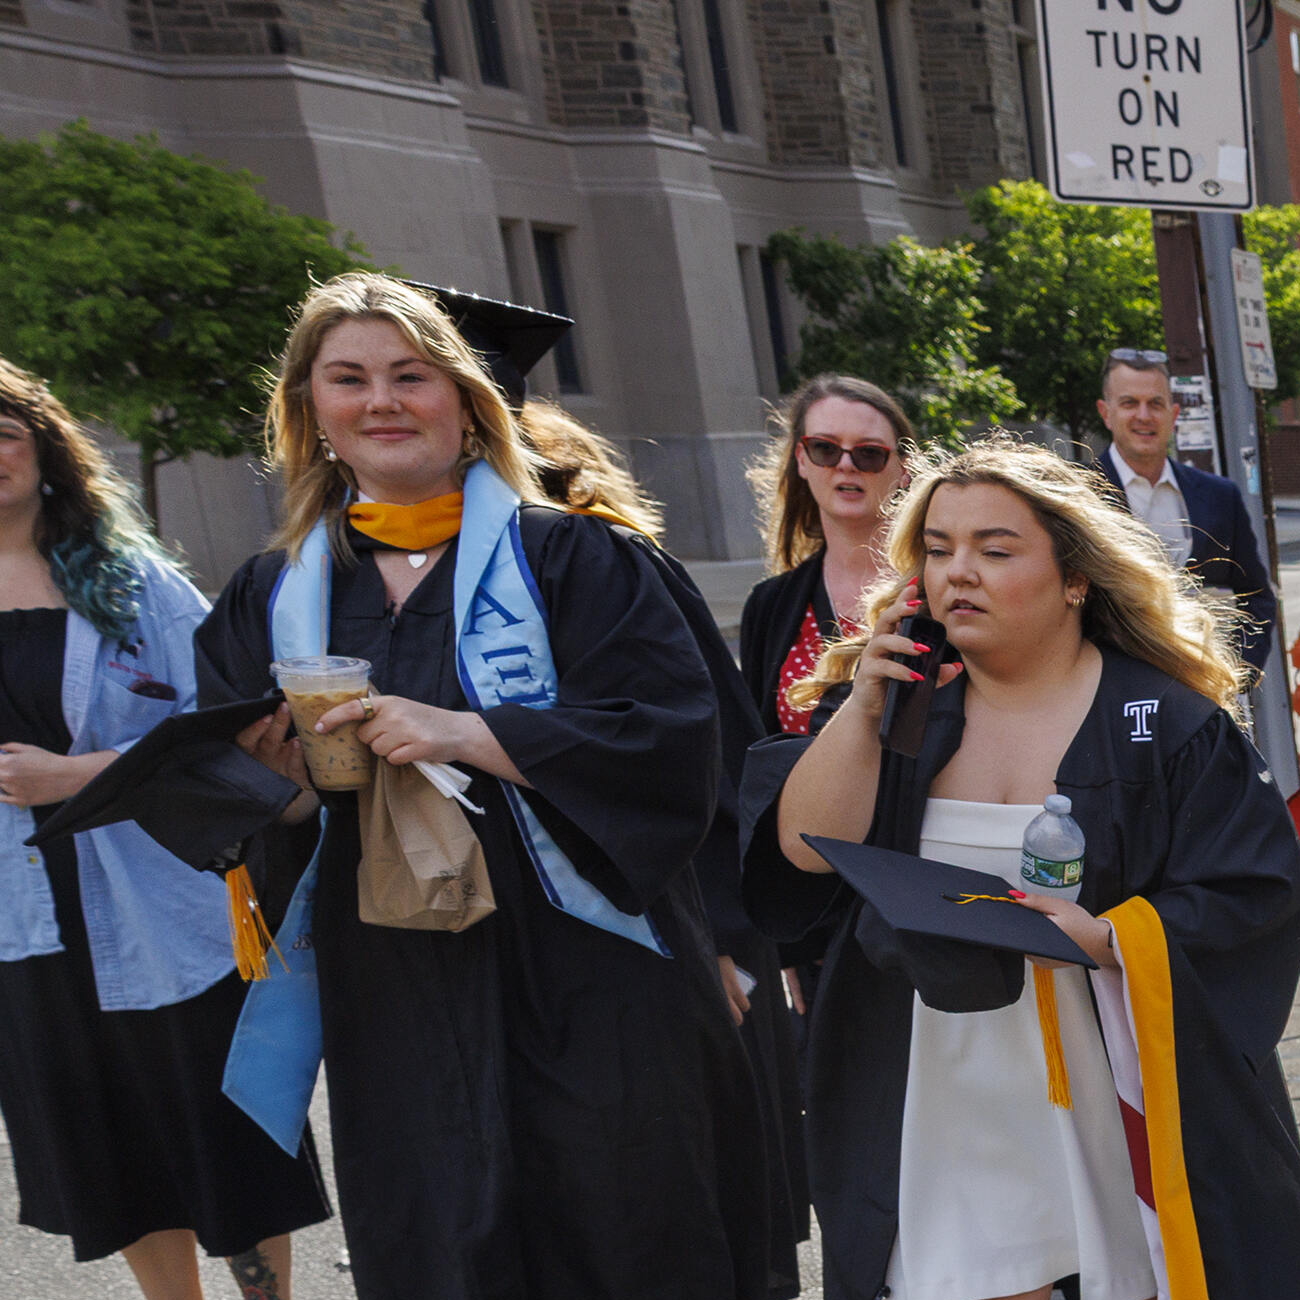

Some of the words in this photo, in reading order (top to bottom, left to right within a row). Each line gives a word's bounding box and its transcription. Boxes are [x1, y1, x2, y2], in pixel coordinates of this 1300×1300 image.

[1085, 29, 1202, 74] TURN
[1118, 87, 1180, 128] ON
[1111, 143, 1193, 184] RED
[1123, 699, 1160, 742] T
